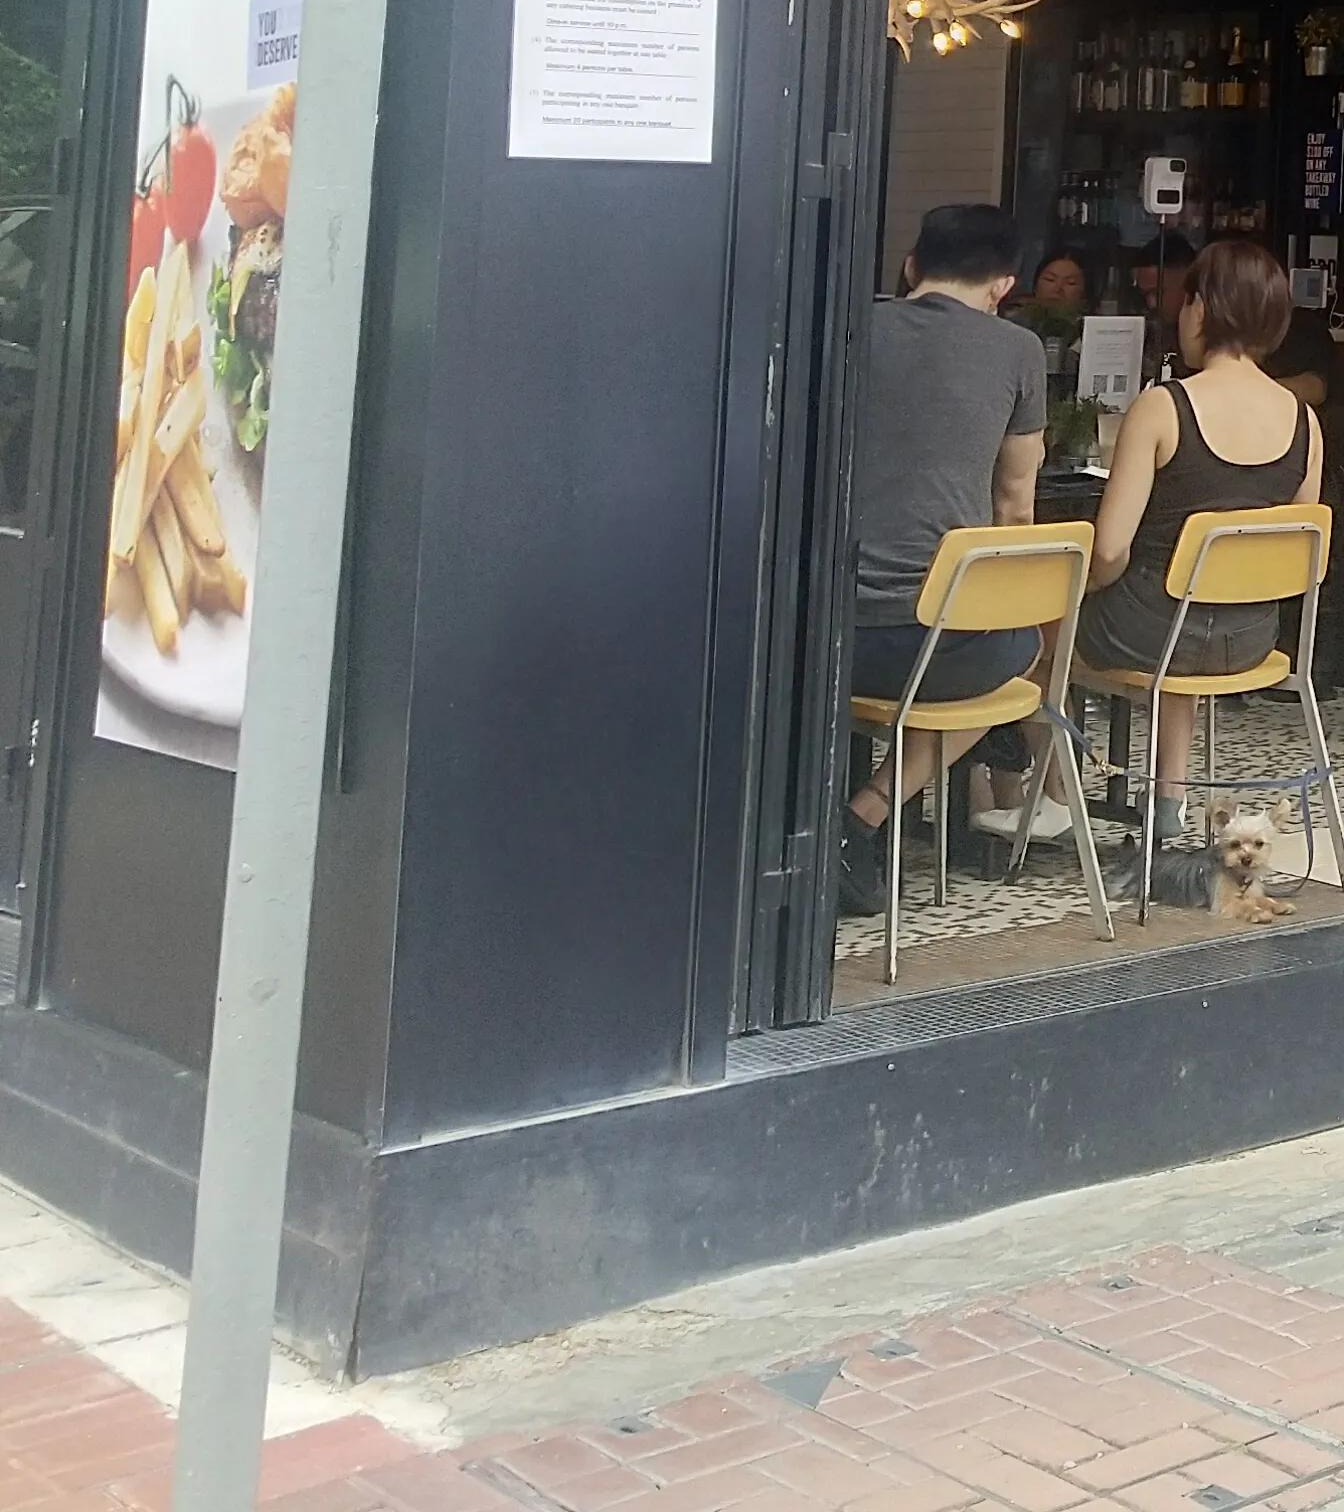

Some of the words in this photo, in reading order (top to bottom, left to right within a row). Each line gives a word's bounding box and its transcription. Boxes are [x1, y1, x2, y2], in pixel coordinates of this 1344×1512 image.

[257, 10, 278, 37] YOU
[256, 35, 299, 68] DESERVE
[1315, 159, 1327, 171] ANY
